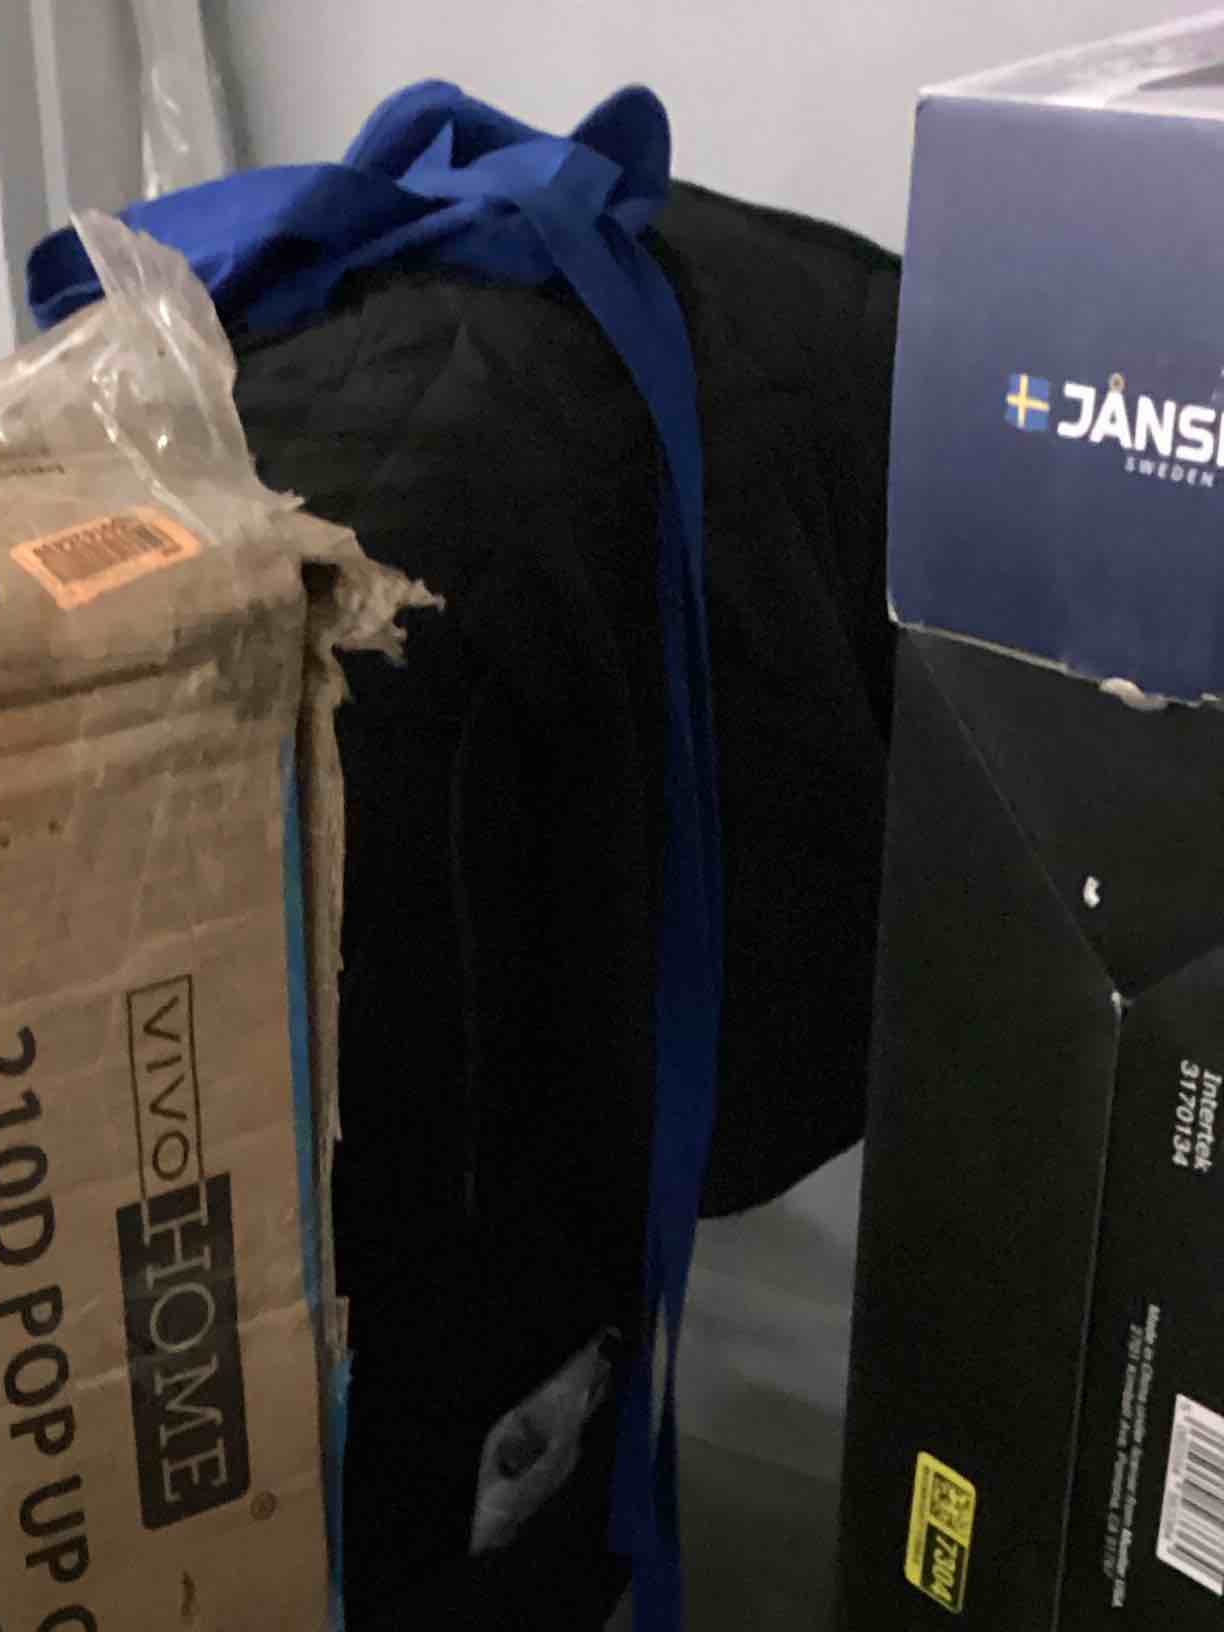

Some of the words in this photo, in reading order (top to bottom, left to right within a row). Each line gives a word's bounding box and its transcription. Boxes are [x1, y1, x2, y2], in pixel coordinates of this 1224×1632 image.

[1124, 456, 1216, 487] SWEDEN
[1172, 1058, 1200, 1168] 3170134
[1192, 1068, 1224, 1173] Intertek
[19, 1476, 90, 1583] UP
